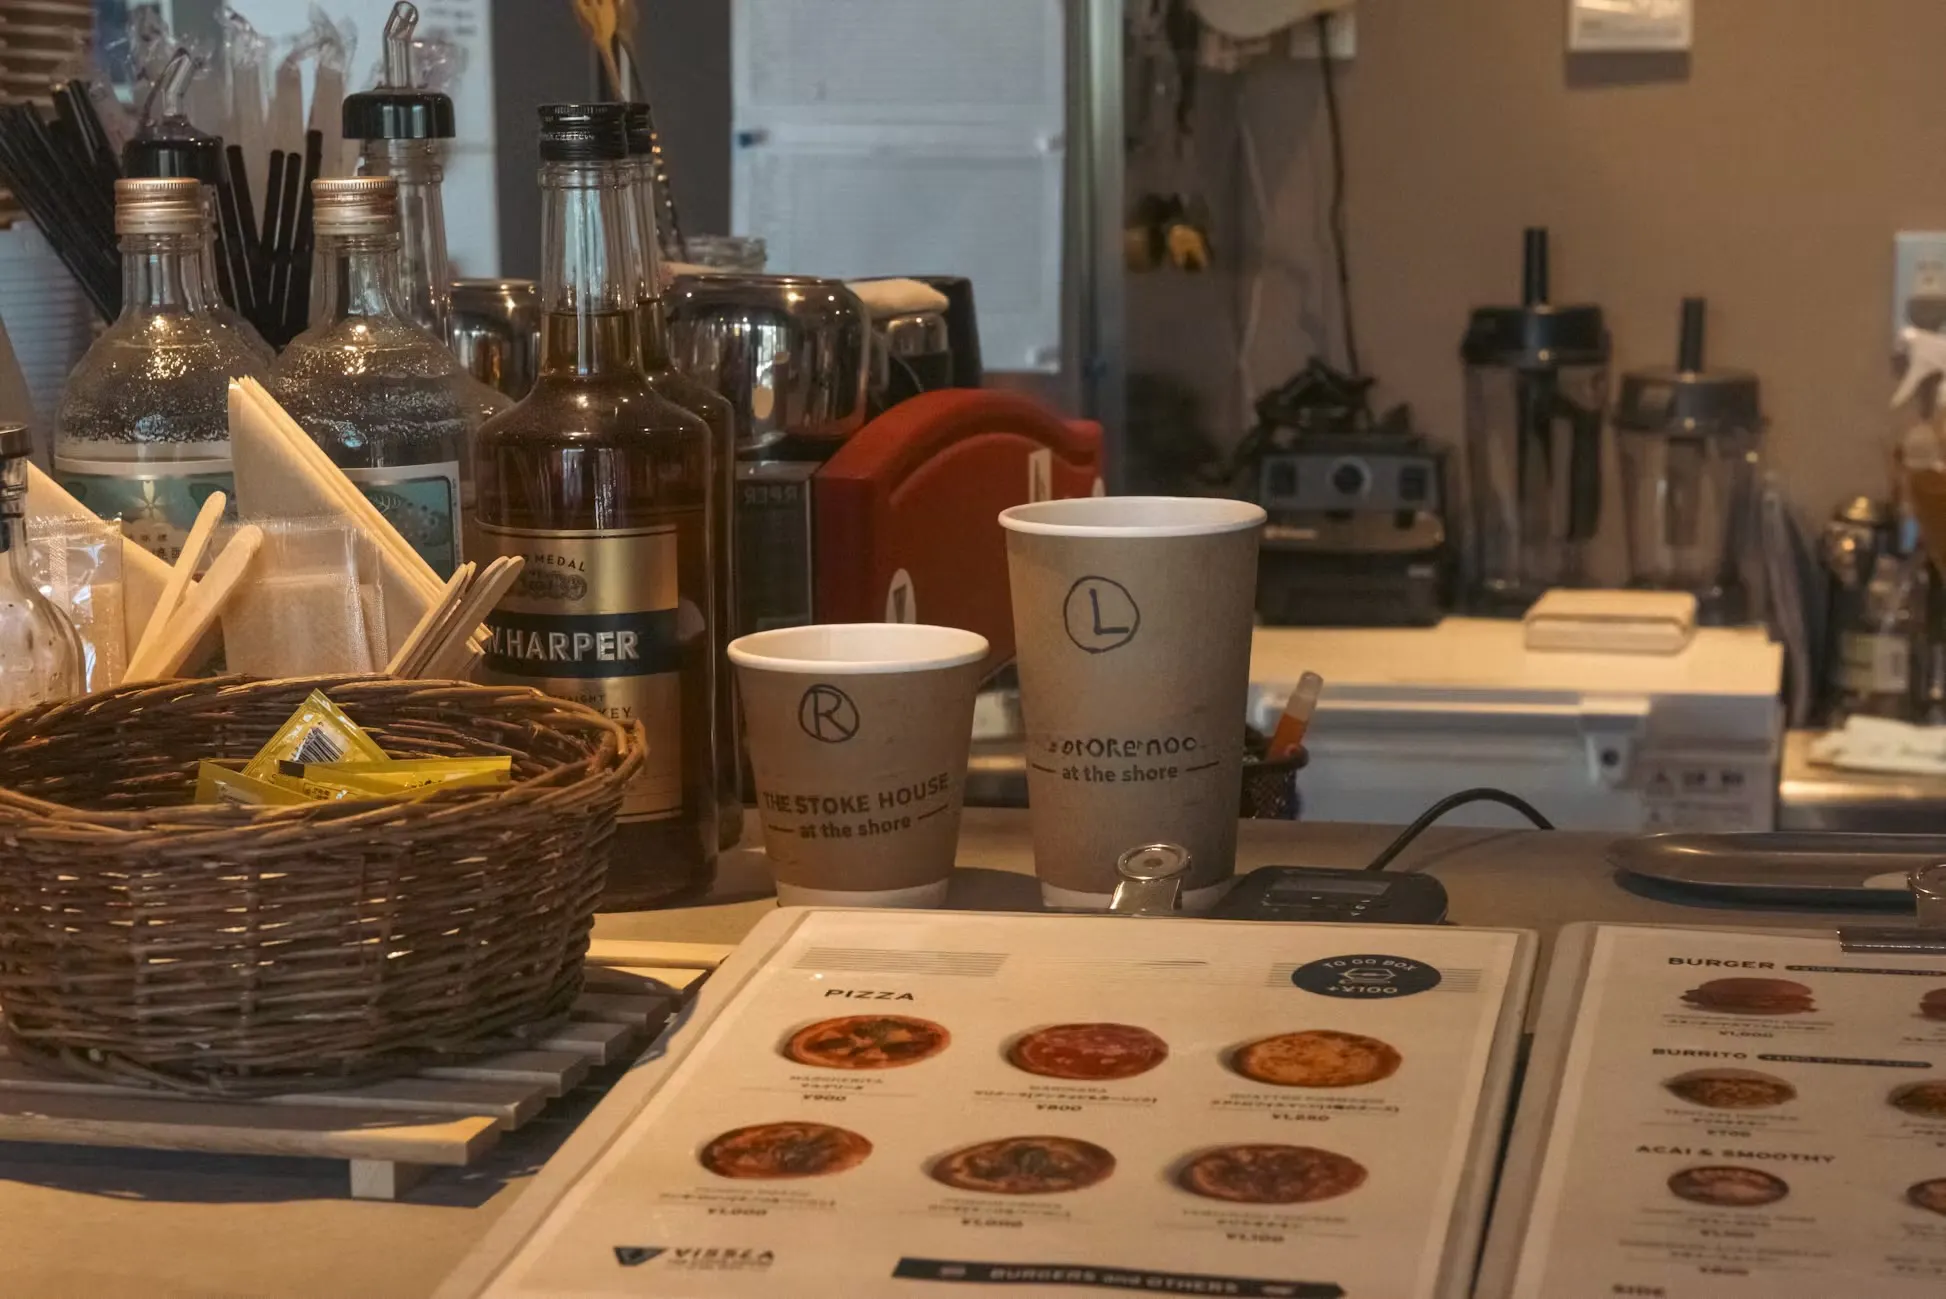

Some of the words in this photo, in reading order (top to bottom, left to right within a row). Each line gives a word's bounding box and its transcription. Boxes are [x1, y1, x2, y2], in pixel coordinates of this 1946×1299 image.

[534, 554, 586, 572] MEDAL
[1089, 588, 1130, 636] L
[810, 687, 851, 739] R
[1062, 766, 1079, 781] at
[1084, 765, 1116, 782] the
[1122, 764, 1178, 782] shore
[794, 794, 870, 815] STOKE
[878, 772, 949, 809] HOUSE
[821, 821, 852, 838] the
[858, 817, 911, 836] shore
[1323, 959, 1346, 969] TO
[1352, 958, 1377, 966] GO
[1382, 959, 1418, 971] BOX
[1668, 957, 1775, 970] BURGER
[824, 988, 914, 1001] PIZZA
[1651, 1048, 1748, 1060] BURRITO
[1635, 1145, 1691, 1156] ACAI
